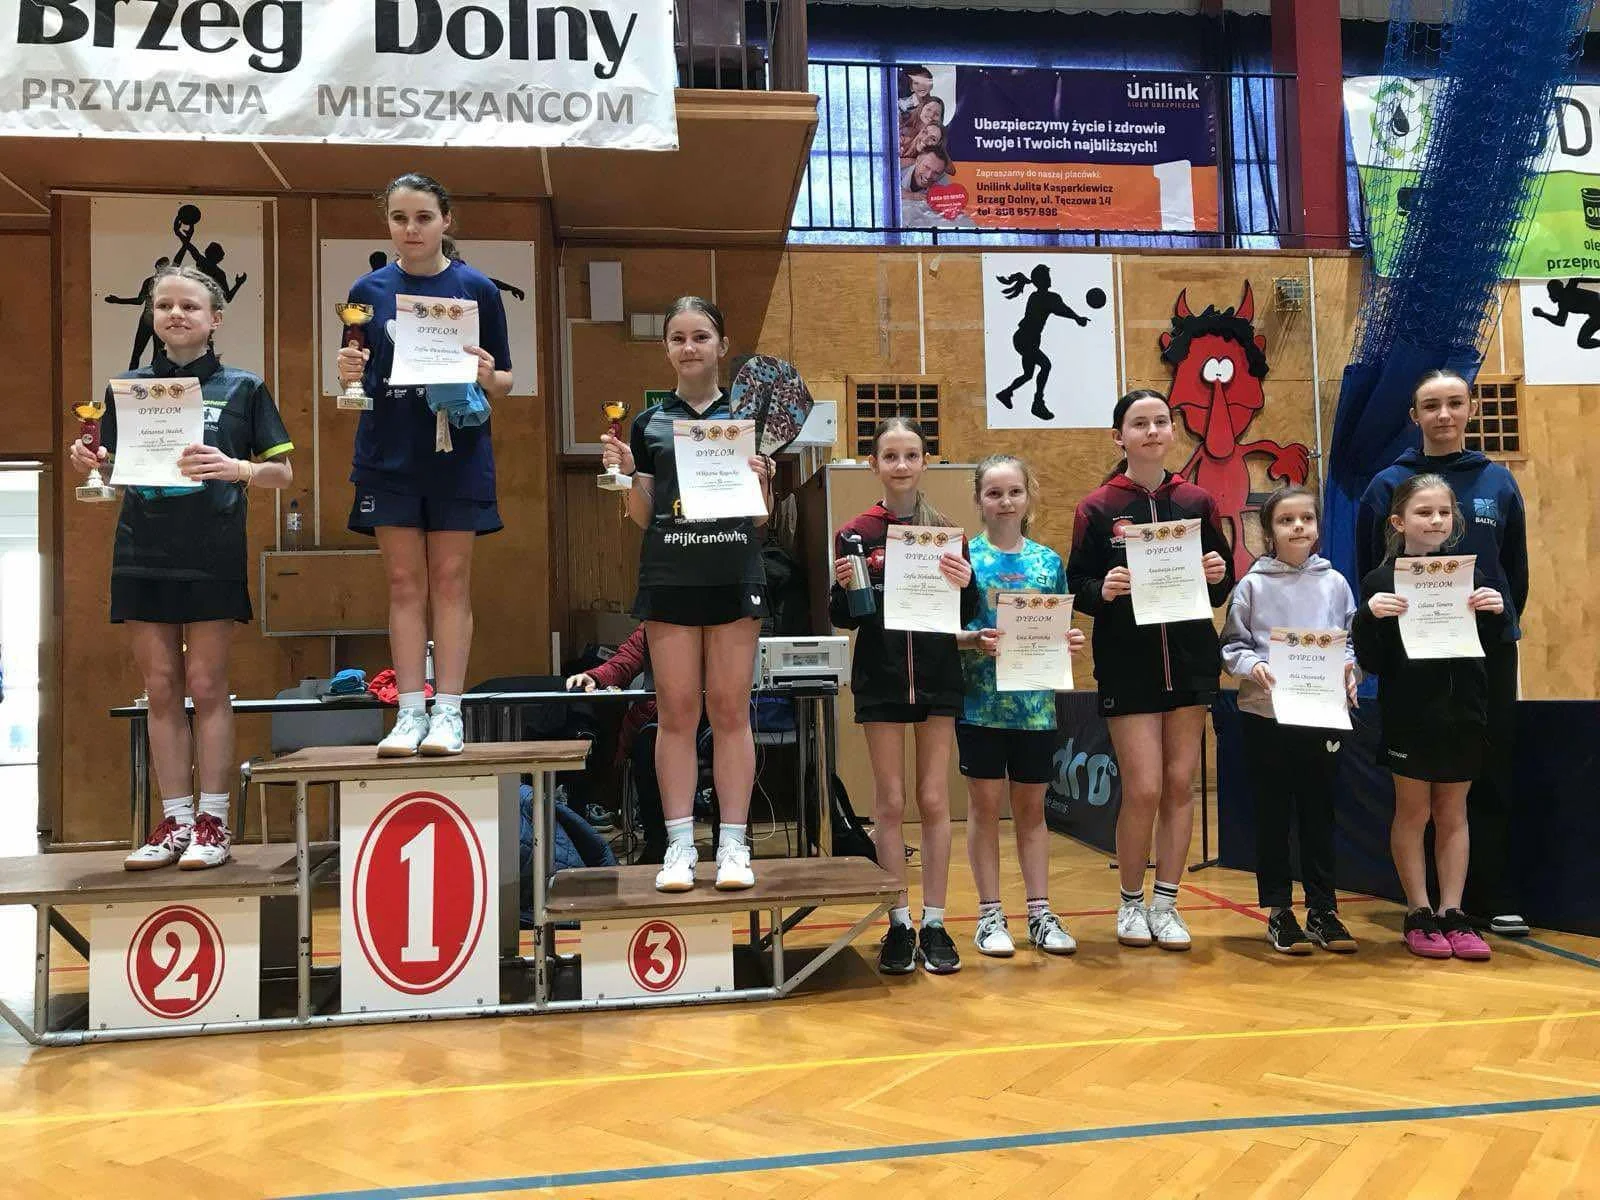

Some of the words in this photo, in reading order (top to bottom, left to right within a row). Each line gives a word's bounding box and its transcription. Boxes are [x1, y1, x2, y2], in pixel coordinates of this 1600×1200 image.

[17, 0, 301, 73] Brzeg
[375, 0, 638, 80] Dolny
[1127, 82, 1199, 101] Unilink
[21, 78, 267, 115] PRZYJAZNA
[318, 82, 635, 126] MIESZKAŃCOM
[974, 118, 1070, 134] Ubezpieczymy
[1072, 119, 1105, 135] życie
[1108, 120, 1112, 132] i
[1114, 121, 1166, 134] zdrowie
[975, 136, 1014, 152] Twoje
[1017, 137, 1021, 149] i
[1023, 137, 1071, 150] Twoich
[1074, 139, 1158, 155] najbliższych!
[1026, 169, 1036, 178] do
[1038, 170, 1063, 180] naszej
[976, 182, 1011, 192] Unilink
[1013, 182, 1041, 191] Julita
[1043, 183, 1114, 193] Kasperkiewicz
[977, 195, 1006, 206] Brzeg
[1008, 195, 1039, 206] Dolny,
[1041, 196, 1053, 205] ul.
[1055, 196, 1097, 206] Tęczowa
[1099, 196, 1111, 206] 14
[416, 326, 458, 336] DYPLOM
[138, 406, 182, 415] DYPLOM
[696, 448, 735, 457] DYPLOM
[664, 530, 748, 547] #PijKranówkę
[1146, 545, 1183, 556] DYPLOM
[1415, 580, 1453, 590] DYPLOM
[1288, 654, 1326, 662] DYPLOM
[400, 822, 440, 964] 1
[150, 919, 199, 1001] 2
[643, 931, 675, 983] 3
